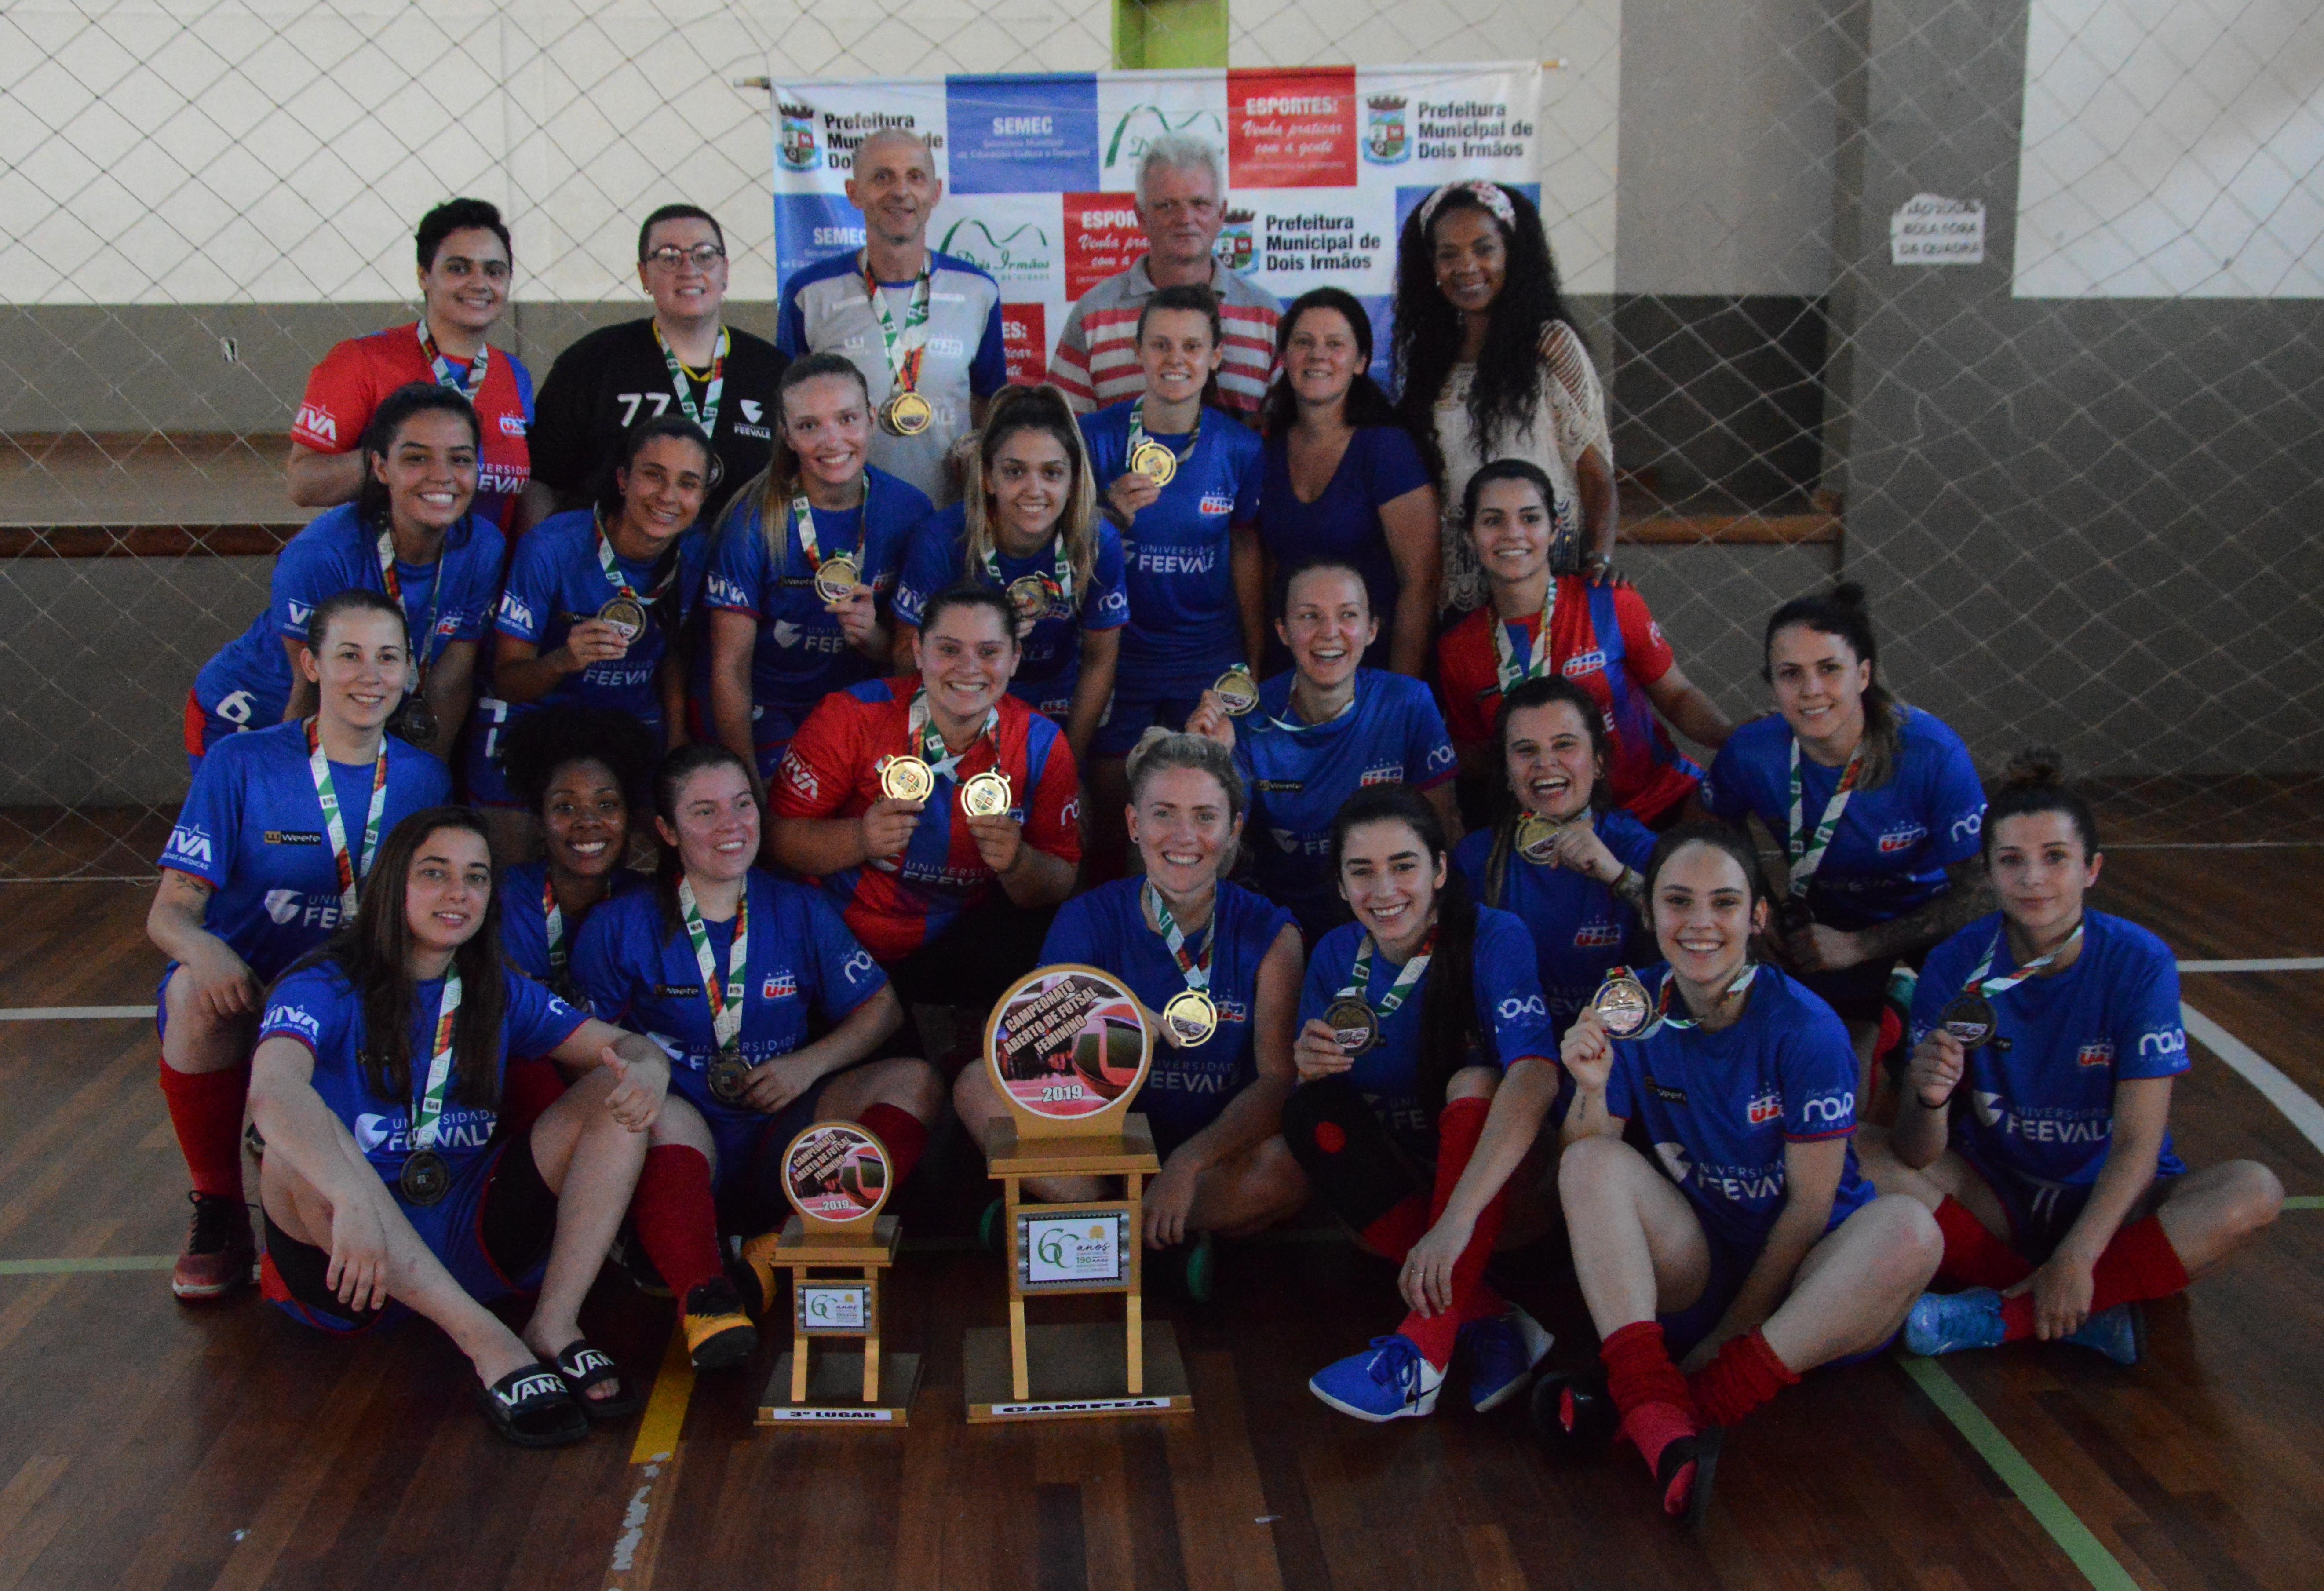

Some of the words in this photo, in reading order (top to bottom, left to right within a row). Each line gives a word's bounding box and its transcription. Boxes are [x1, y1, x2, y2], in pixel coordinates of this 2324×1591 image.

[1418, 101, 1507, 118] Prefeitura
[824, 112, 915, 129] Prefeitura
[993, 117, 1053, 135] SEMEC
[1241, 120, 1283, 137] Venha
[1418, 120, 1506, 140] Municipal
[1511, 119, 1534, 136] de
[1419, 140, 1456, 158] Dois
[1463, 139, 1524, 157] Irmãos
[1081, 209, 1139, 229] ESPOR
[1266, 213, 1354, 231] Prefeitura
[1078, 233, 1120, 251] Venha
[1266, 232, 1353, 253] Municipal
[1359, 231, 1381, 249] de
[1266, 253, 1305, 271] Dois
[1310, 252, 1372, 271] Irmãos
[617, 393, 671, 427] 77
[295, 407, 337, 442] IVA
[500, 595, 533, 629] IVA
[165, 830, 212, 862] IVA
[1005, 979, 1076, 1033] CAMPEONATO
[1003, 1021, 1046, 1055] ABERTO
[1043, 1012, 1060, 1028] DE
[1057, 986, 1099, 1018] FUTSAL
[1033, 1014, 1087, 1055] FEMININO
[1041, 1084, 1083, 1102] 2019
[793, 1132, 837, 1168] CAMPEONATO
[794, 1159, 821, 1182] ABERTO
[818, 1153, 829, 1164] DE
[826, 1136, 852, 1158] FUTSAL
[814, 1154, 846, 1181] FEMININO
[823, 1199, 850, 1211] 2019
[1076, 1242, 1110, 1252] anos
[497, 1373, 569, 1407] VANS
